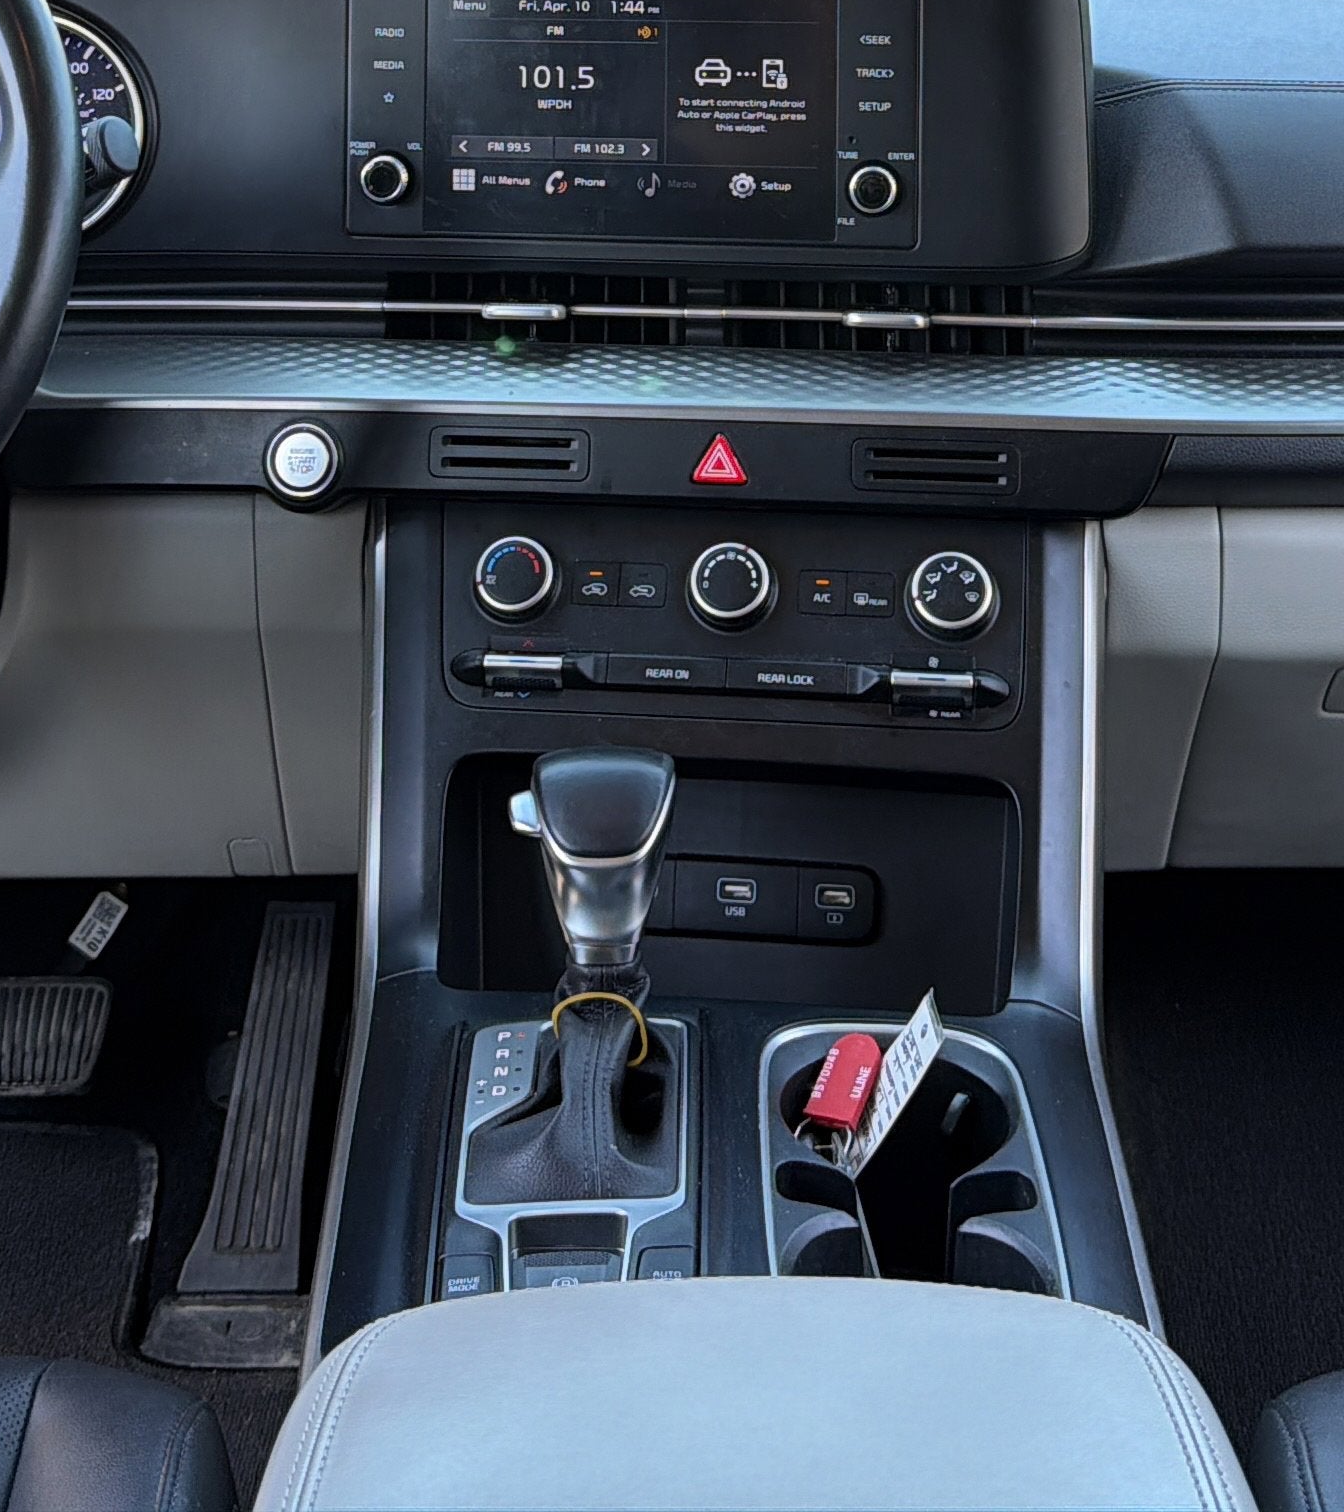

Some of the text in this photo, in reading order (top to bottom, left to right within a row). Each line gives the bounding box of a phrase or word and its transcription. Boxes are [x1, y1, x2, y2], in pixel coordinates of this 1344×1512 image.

[453, 0, 487, 11] Menu
[543, 0, 571, 13] Apr.
[575, 0, 590, 12] 10
[610, 0, 645, 14] 1:44
[374, 27, 405, 37] RADIO
[546, 26, 564, 35] FM
[373, 59, 405, 71] MEDIA
[518, 64, 595, 91] 101.5
[92, 88, 115, 101] 120
[537, 99, 572, 109] WPDH
[679, 97, 806, 108] To start connecting Android
[858, 101, 892, 112] SETUP
[677, 110, 700, 119] Auto
[713, 111, 740, 121] Apple
[780, 112, 807, 122] press
[715, 123, 733, 132] this
[407, 142, 423, 151] VOL
[487, 142, 531, 153] FM 99.5
[574, 144, 625, 155] FM 102.3
[837, 150, 915, 161] TUNE ENTER
[482, 175, 531, 186] All Menus
[574, 176, 606, 188] Phone
[667, 178, 697, 189] Media
[761, 181, 792, 193] Setup
[837, 217, 855, 225] FILE
[812, 592, 831, 604] A/C
[868, 598, 888, 606] REAR
[646, 668, 689, 679] REAR ON
[757, 672, 814, 685] REAR LOCK
[941, 711, 961, 719] REAR
[725, 906, 746, 917] USB
[497, 1031, 511, 1042] P
[494, 1067, 508, 1077] N
[849, 1066, 872, 1100] ULINE
[492, 1085, 507, 1096] D
[652, 1270, 682, 1279] AUTO
[447, 1275, 480, 1286] DRIVE
[447, 1284, 480, 1293] MODE
